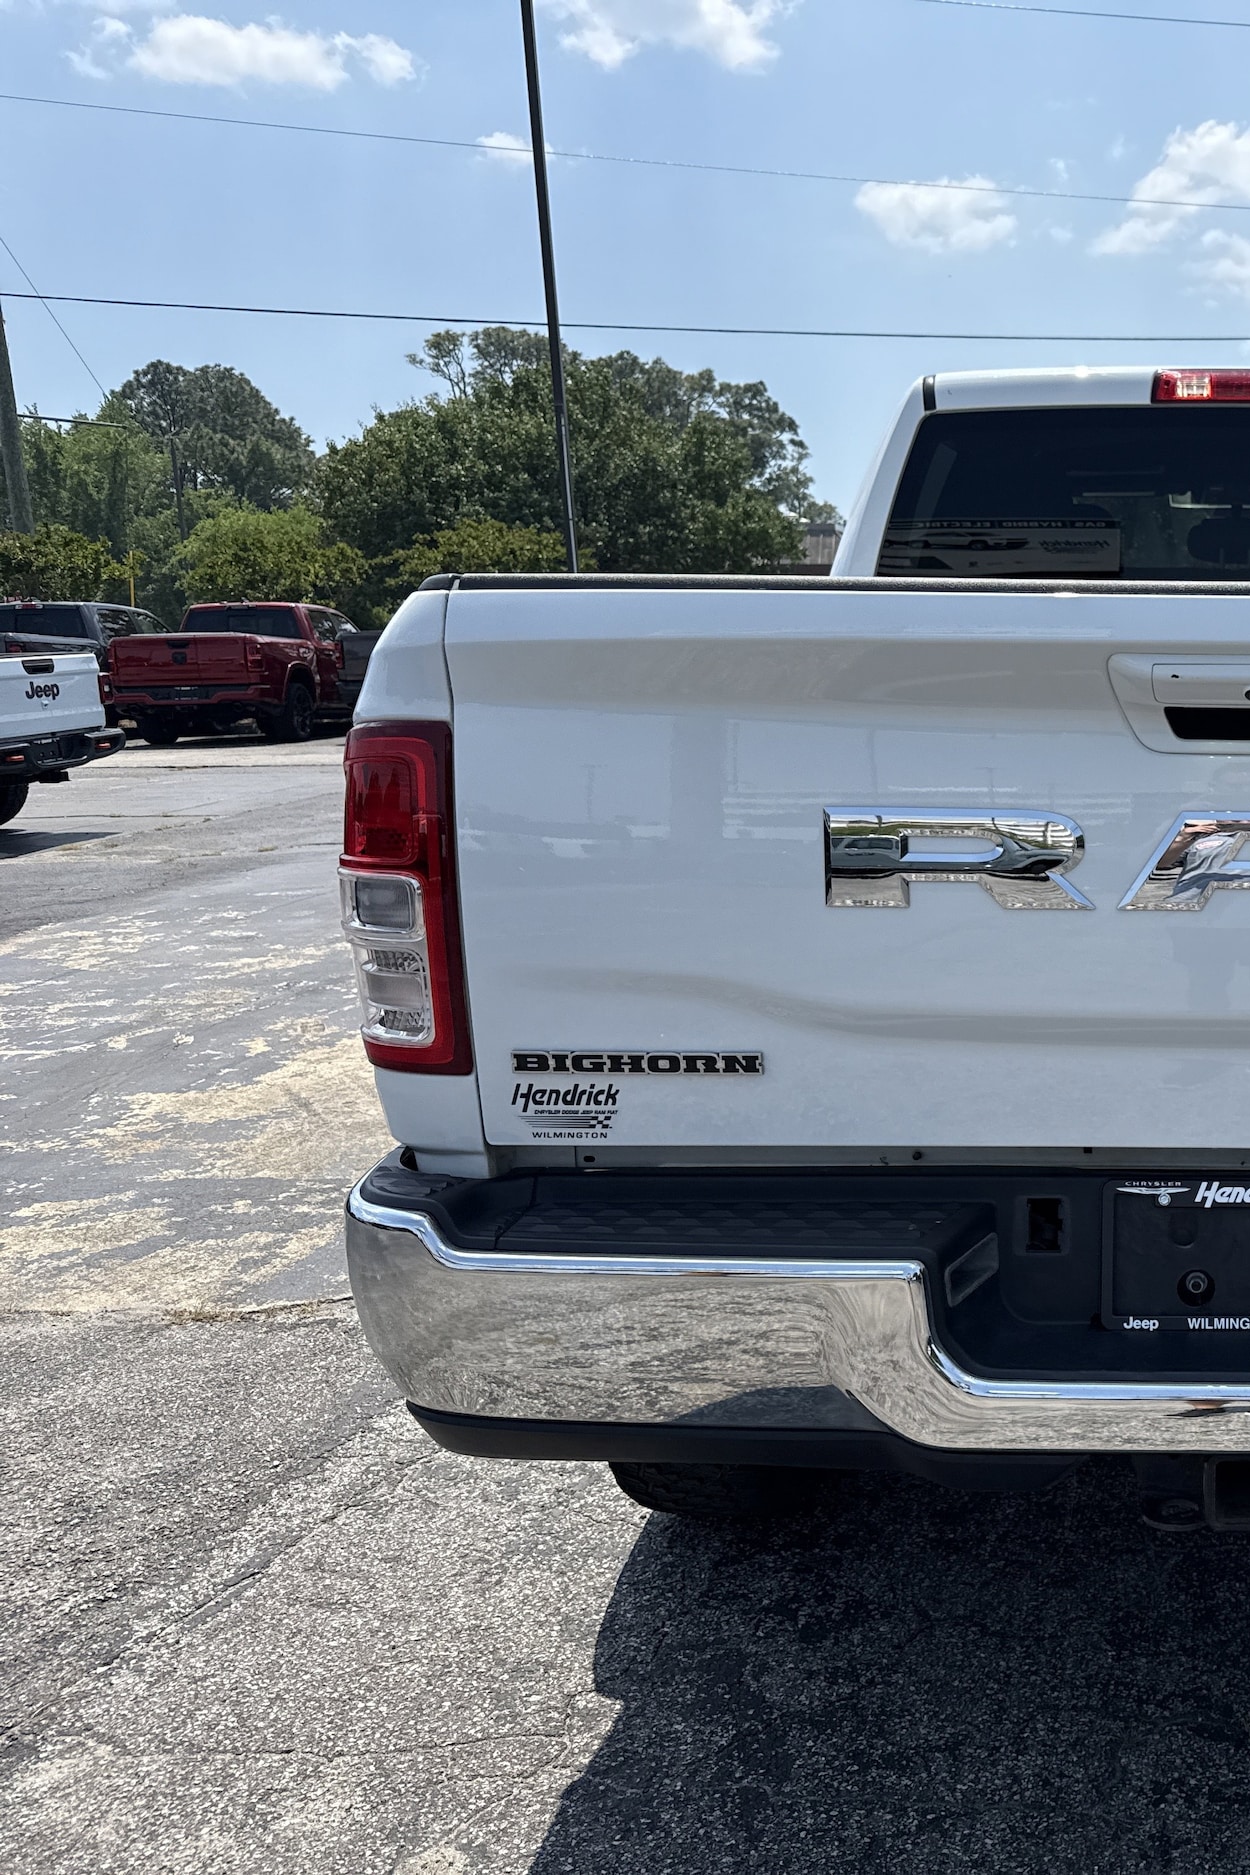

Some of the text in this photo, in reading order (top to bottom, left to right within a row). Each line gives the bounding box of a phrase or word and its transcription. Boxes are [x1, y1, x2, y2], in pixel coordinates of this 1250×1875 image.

[25, 681, 60, 701] Jeep
[512, 1050, 765, 1075] BIGHORN
[511, 1083, 620, 1113] Hendrick
[531, 1131, 608, 1139] WILMINGTON
[1123, 1316, 1159, 1331] Jeep
